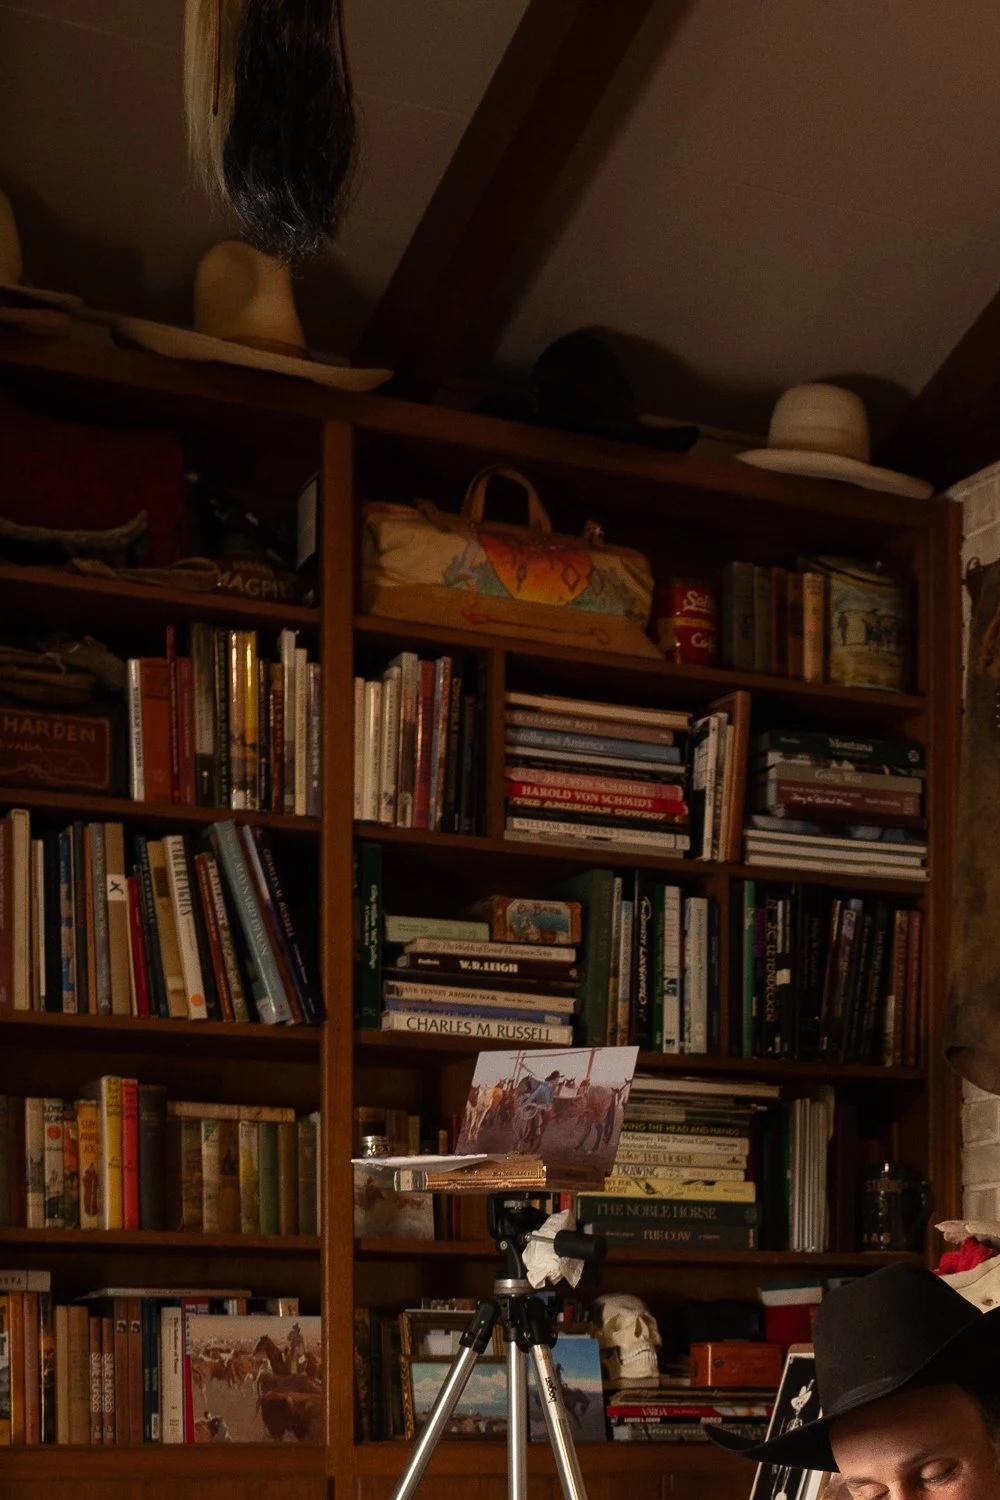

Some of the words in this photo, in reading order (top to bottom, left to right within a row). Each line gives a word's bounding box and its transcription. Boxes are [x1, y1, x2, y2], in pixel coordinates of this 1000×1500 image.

[3, 715, 97, 743] HARDEN
[521, 785, 572, 800] HAROLD
[574, 790, 599, 803] VON
[601, 793, 653, 808] SCHMIDT
[513, 797, 541, 806] THE
[543, 800, 613, 814] AMERICAN
[615, 808, 666, 820] COWBOY
[234, 861, 257, 918] MAYNARD
[249, 918, 268, 957] DIXON
[765, 943, 778, 1023] LEYENDECKER
[406, 1016, 472, 1036] CHARLES
[476, 1024, 494, 1037] M.
[497, 1025, 553, 1042] RUSSELL
[648, 1123, 663, 1132] THE
[666, 1124, 689, 1133] HEAD
[690, 1126, 709, 1134] AND
[710, 1127, 740, 1136] HANDS
[616, 1163, 658, 1177] DRAWING
[593, 1202, 624, 1216] THE
[626, 1203, 671, 1217] NOBLE
[673, 1205, 717, 1219] HORSE
[665, 1230, 692, 1241] COW
[642, 1407, 668, 1416] VARGA
